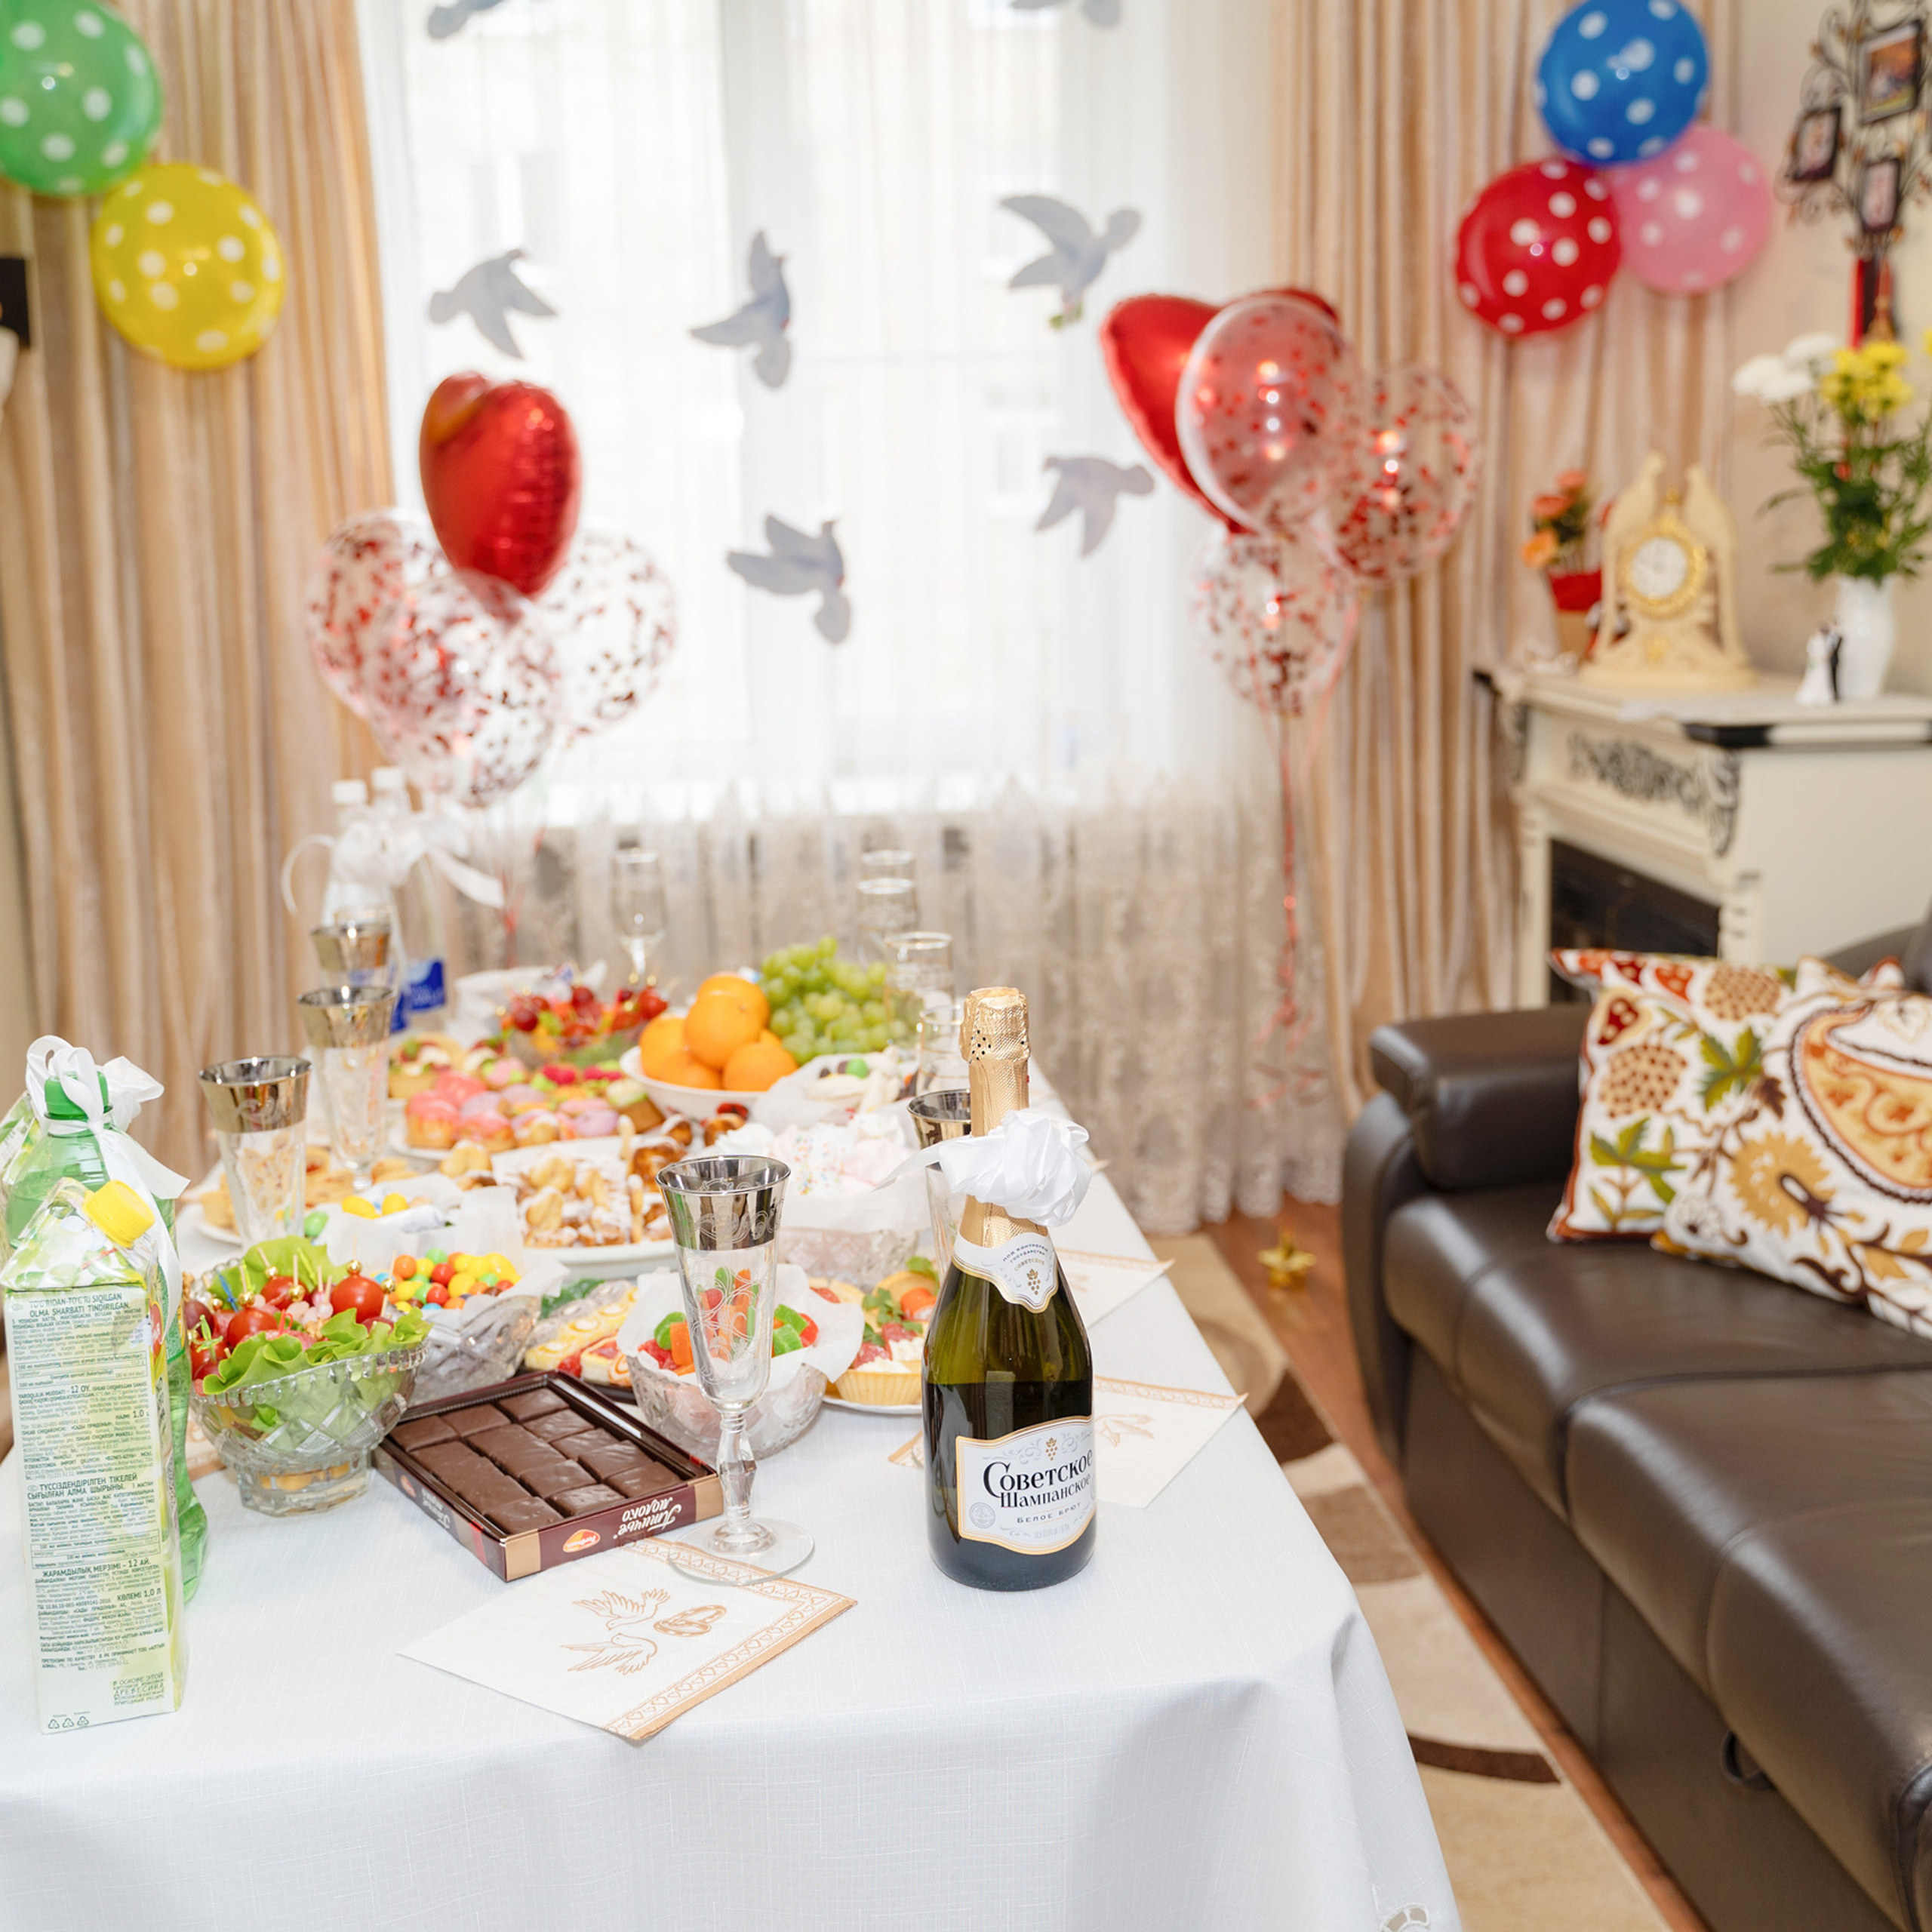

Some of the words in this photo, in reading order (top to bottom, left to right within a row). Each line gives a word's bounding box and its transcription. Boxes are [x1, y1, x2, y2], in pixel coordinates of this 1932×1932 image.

[29, 1309, 49, 1318] OLMA
[52, 1306, 85, 1315] SHARBATI
[133, 1410, 144, 1418] 1.0
[109, 1472, 137, 1484] ТІКЕЛЕЙ
[983, 1449, 1093, 1498] Советское
[67, 1487, 87, 1496] АЛМА
[1001, 1473, 1091, 1508] Шампанское
[93, 1562, 121, 1573] МЕРЗІМІ
[128, 1559, 137, 1568] 12
[117, 1592, 142, 1601] КӨЛЕМІ
